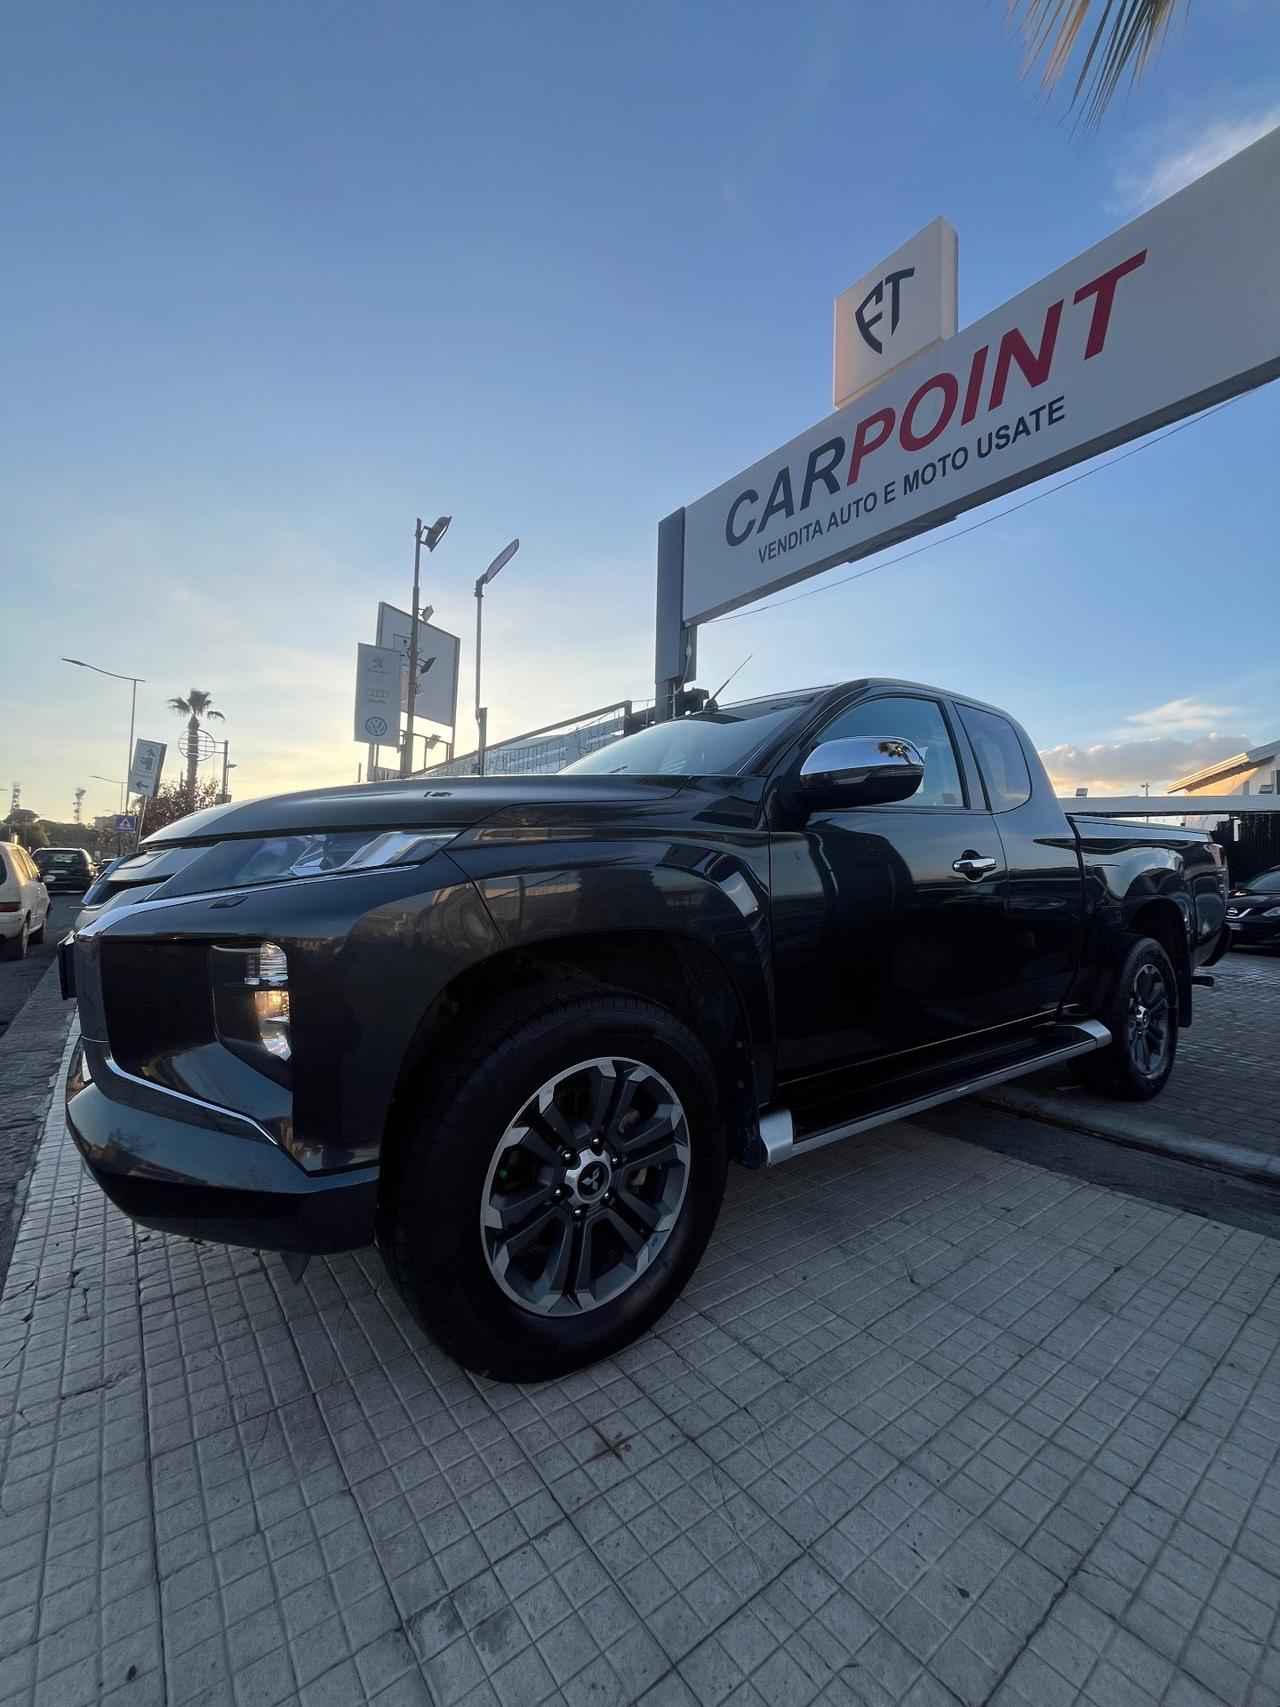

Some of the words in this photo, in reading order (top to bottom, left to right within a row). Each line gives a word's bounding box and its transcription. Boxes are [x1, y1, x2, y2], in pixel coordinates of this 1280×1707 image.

[758, 520, 823, 564] VENDITA
[827, 492, 877, 532] AUTO
[884, 481, 896, 504] E
[904, 447, 968, 495] MOTO
[977, 395, 1065, 458] USATE
